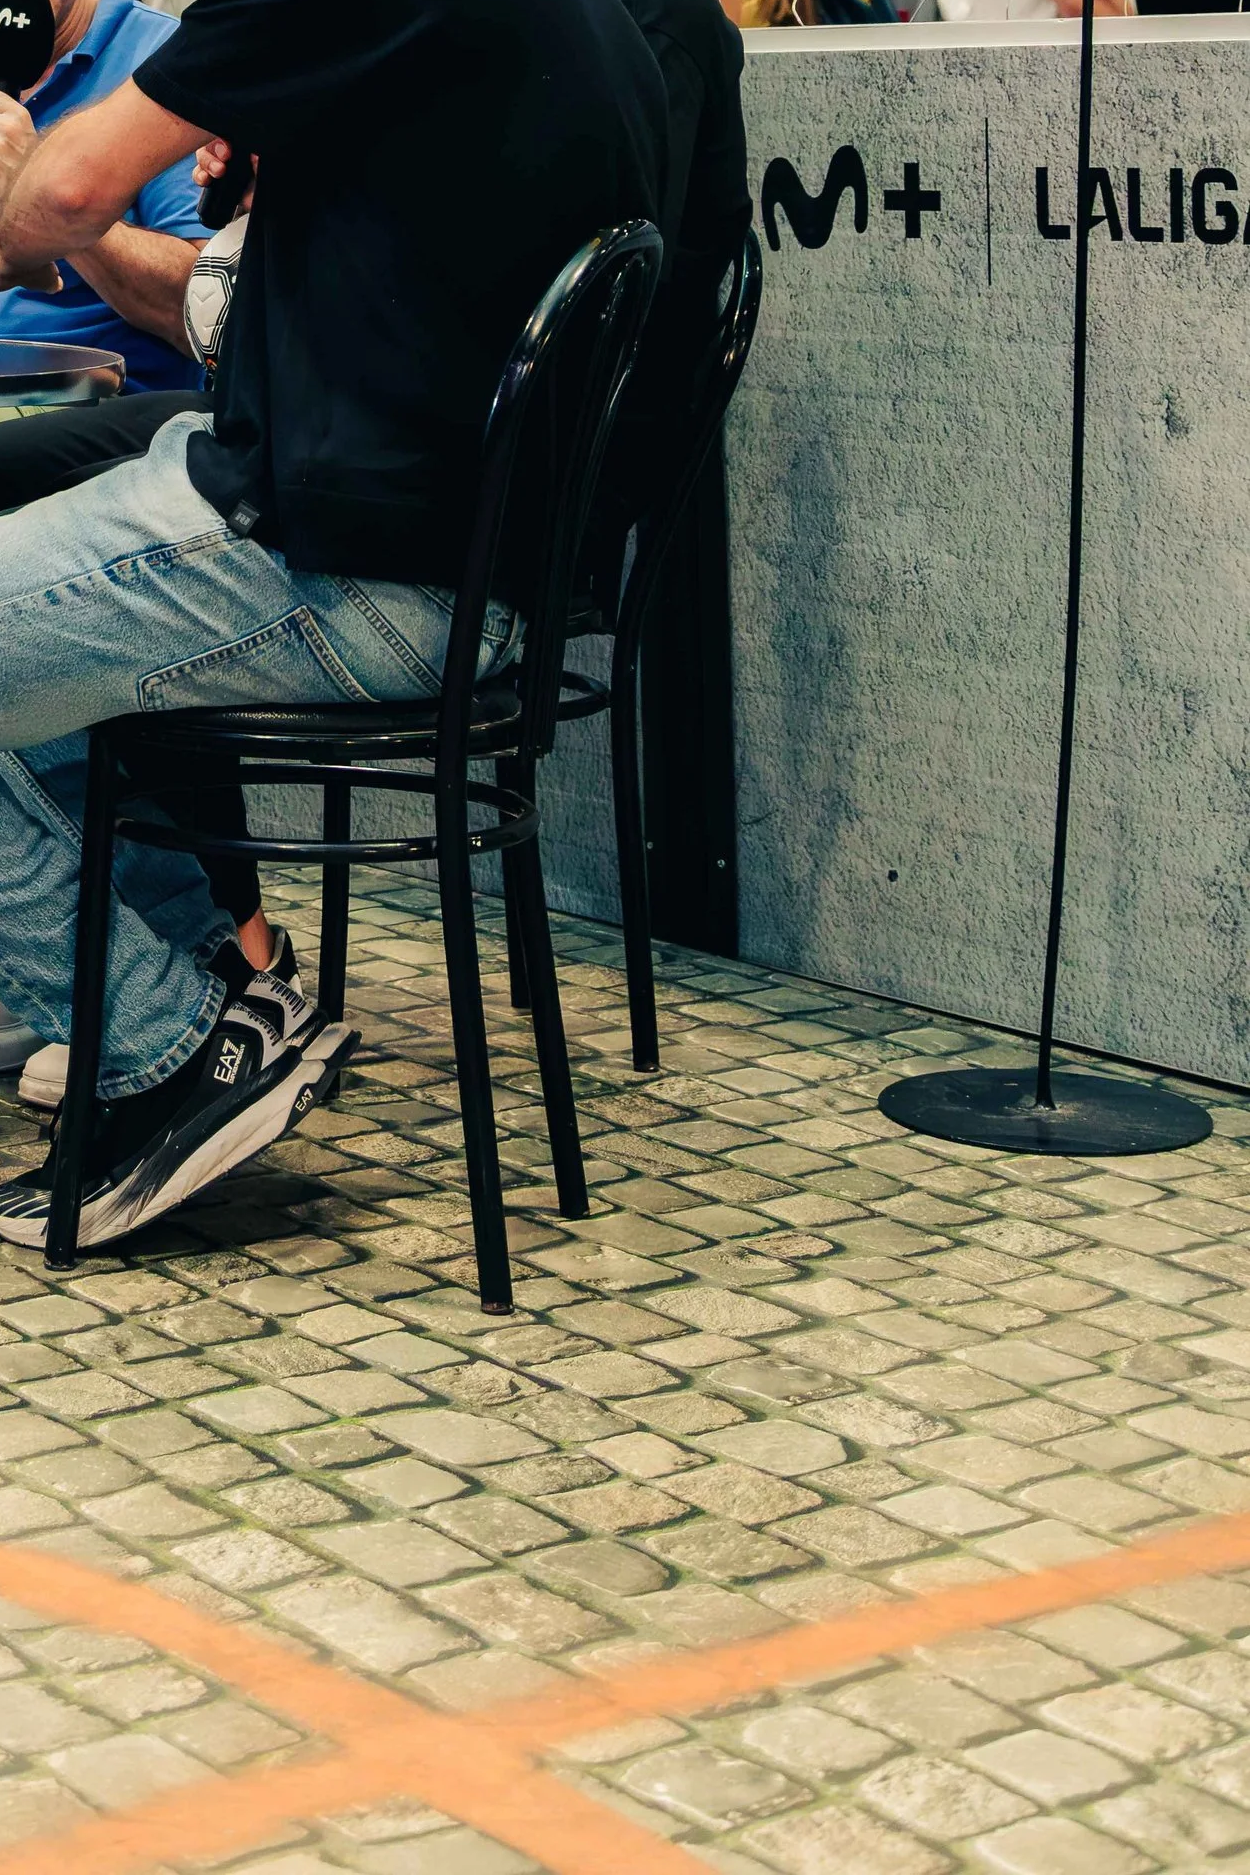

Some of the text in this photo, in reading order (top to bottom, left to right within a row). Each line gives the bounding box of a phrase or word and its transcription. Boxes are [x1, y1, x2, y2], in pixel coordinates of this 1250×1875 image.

[1035, 166, 1250, 245] LALIG
[213, 1037, 240, 1083] EA7
[295, 1087, 313, 1112] EA7
